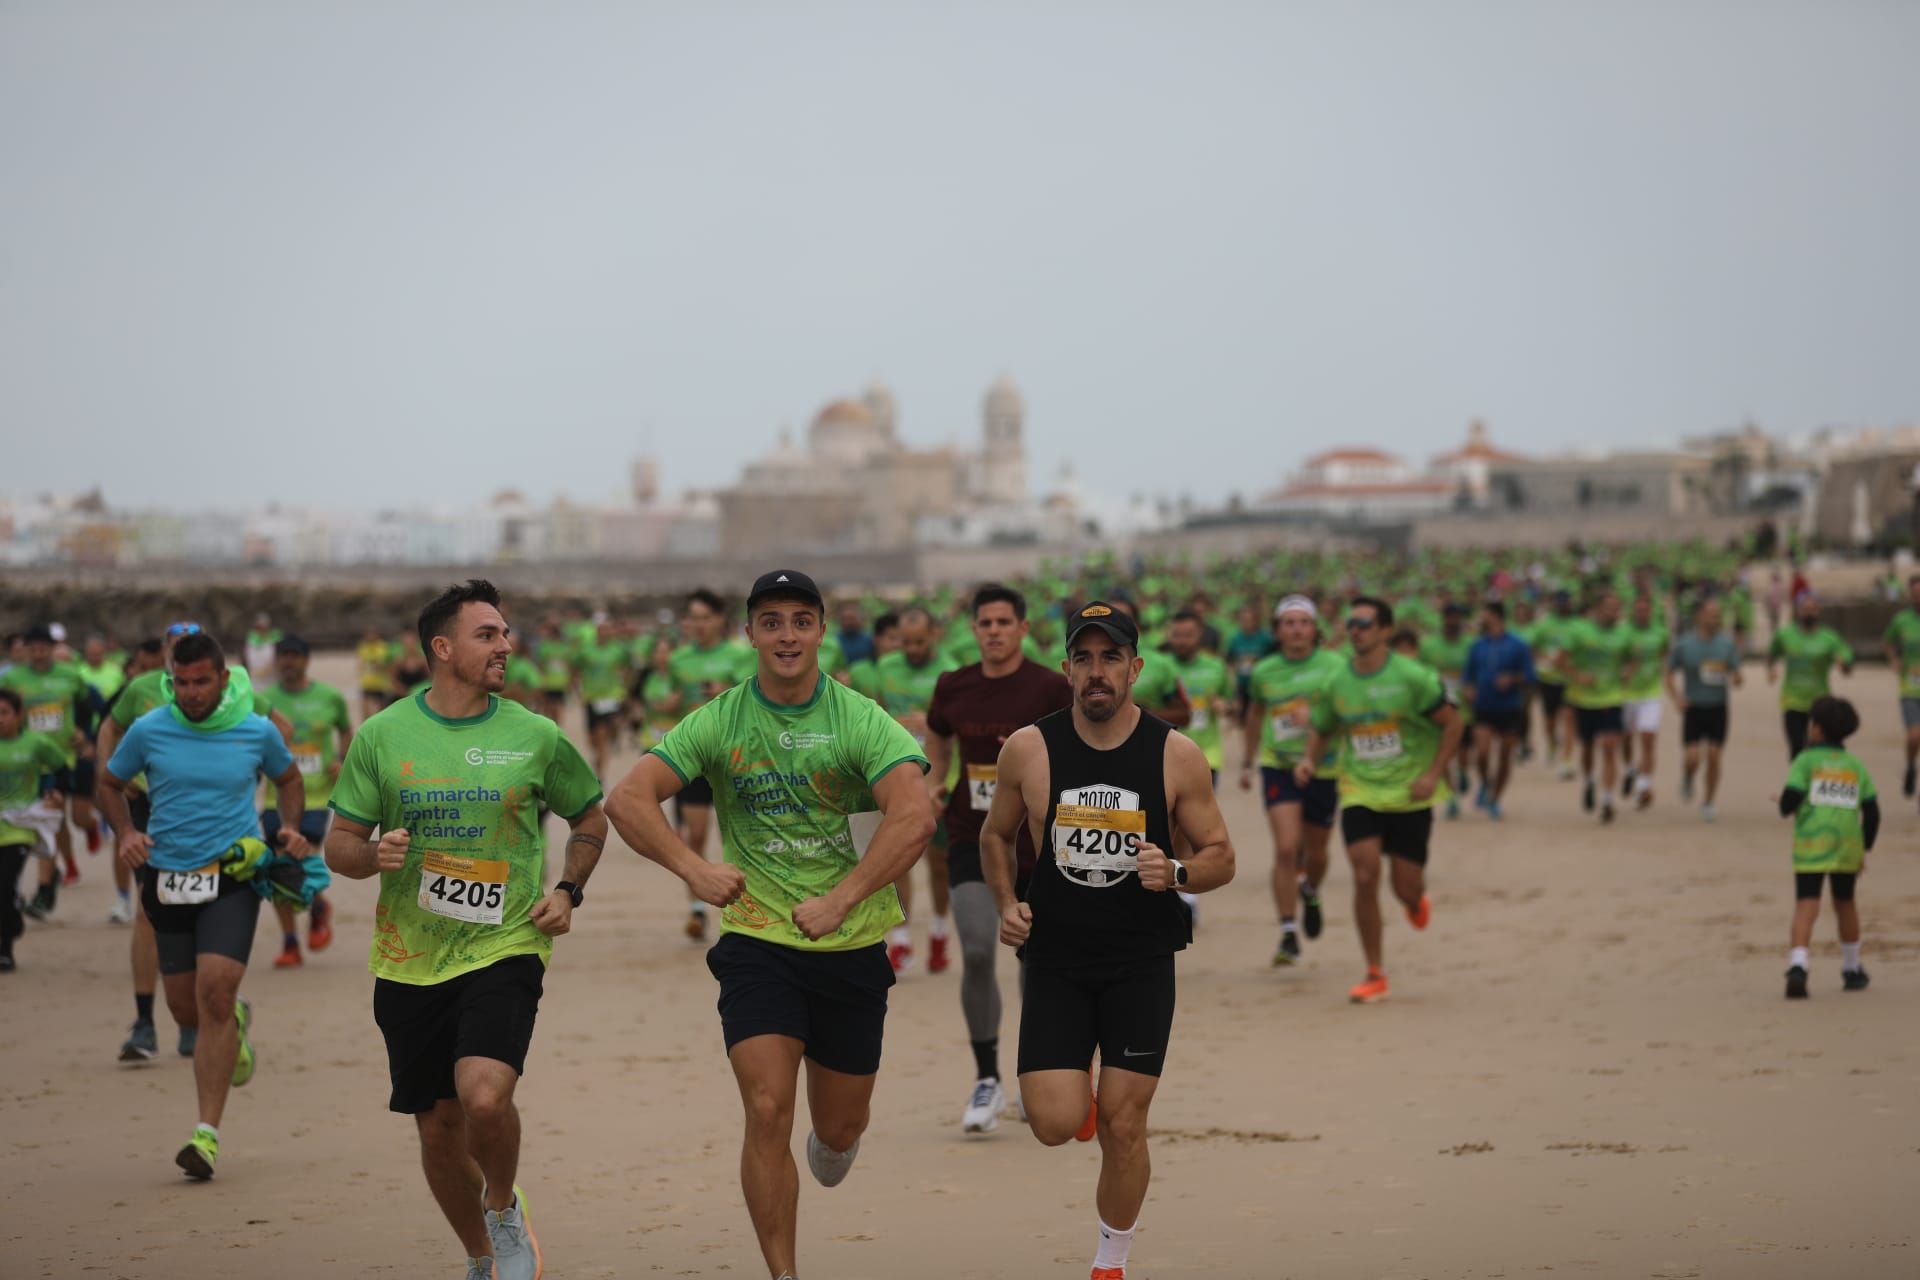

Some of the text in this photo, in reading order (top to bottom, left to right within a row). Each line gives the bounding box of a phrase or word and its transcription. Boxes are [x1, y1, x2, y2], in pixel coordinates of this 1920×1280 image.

[733, 776, 755, 793] En
[400, 786, 501, 804] En marcha
[1079, 791, 1121, 809] MOTOR
[423, 823, 487, 838] cáncer
[1066, 828, 1141, 857] 4209
[165, 871, 215, 892] 4721
[429, 875, 502, 909] 4205
